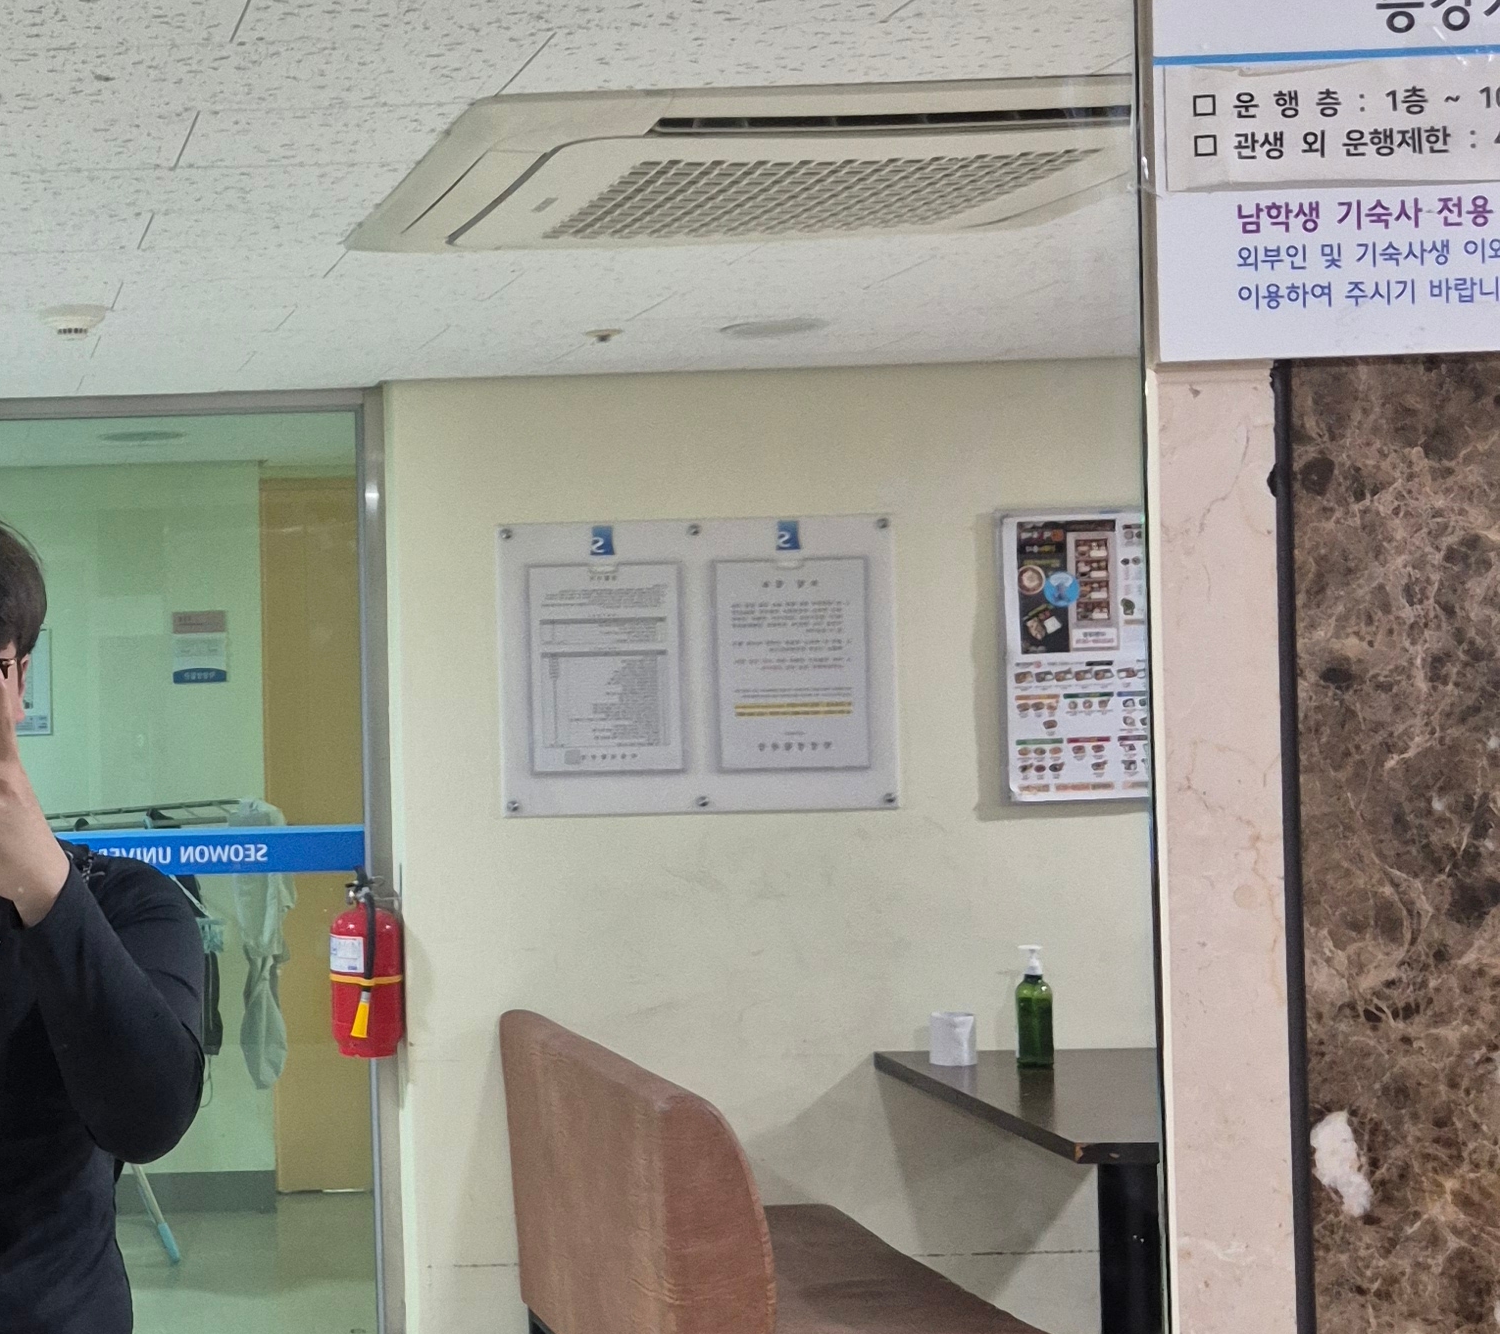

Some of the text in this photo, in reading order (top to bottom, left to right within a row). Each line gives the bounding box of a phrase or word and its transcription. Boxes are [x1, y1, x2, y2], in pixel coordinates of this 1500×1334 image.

[1232, 91, 1260, 119] 운
[1273, 89, 1300, 118] 행
[1315, 90, 1342, 117] 층
[1385, 85, 1429, 115] 1층
[1233, 130, 1285, 160] 관생
[1301, 129, 1326, 158] 외
[1342, 126, 1451, 156] 운행제한
[1237, 194, 1494, 234] 남학생 기숙사 전용
[1237, 243, 1308, 270] 외부인
[1320, 242, 1343, 269] 및
[1356, 239, 1450, 267] 기숙사생
[1238, 280, 1333, 310] 이용하여
[1344, 278, 1416, 307] 주시기
